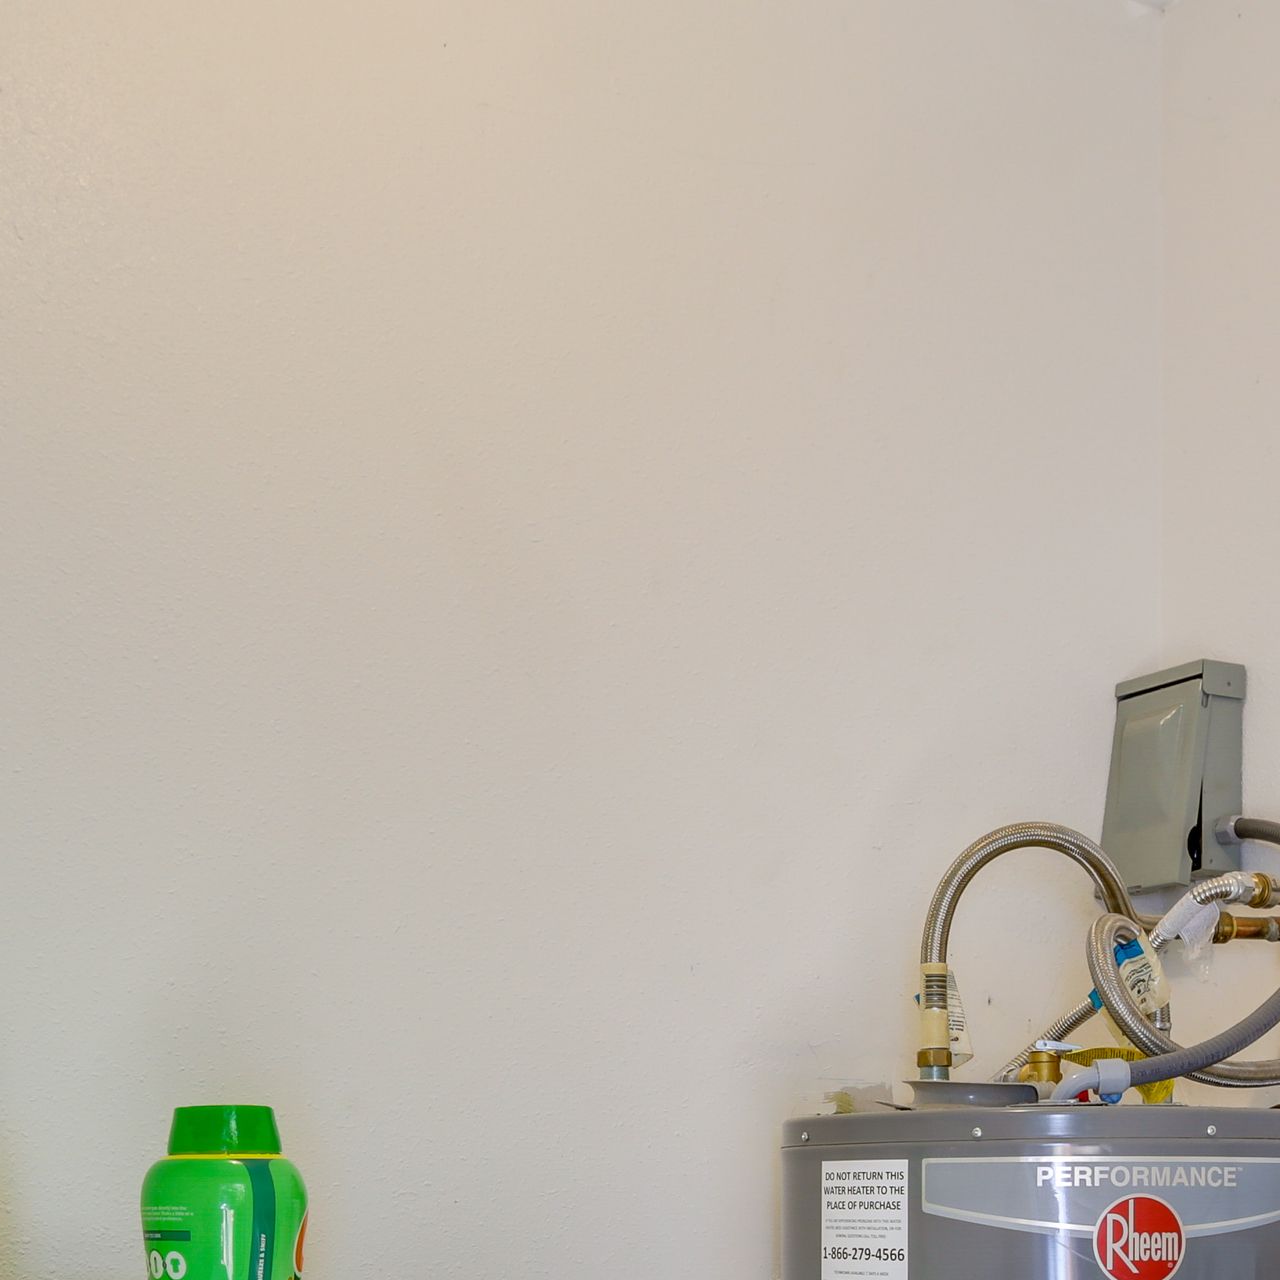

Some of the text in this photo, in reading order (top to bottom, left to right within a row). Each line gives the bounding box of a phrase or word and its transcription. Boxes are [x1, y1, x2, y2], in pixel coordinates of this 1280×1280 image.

[825, 1171, 904, 1181] DO NOT RETURN THIS
[1036, 1166, 1237, 1187] PERFORMANCE
[824, 1186, 905, 1195] WATER HEATER TO THE
[826, 1200, 901, 1210] PLACE OF PURCHASE
[1106, 1198, 1179, 1274] Rheem
[823, 1246, 905, 1261] 1-866-279-4566
